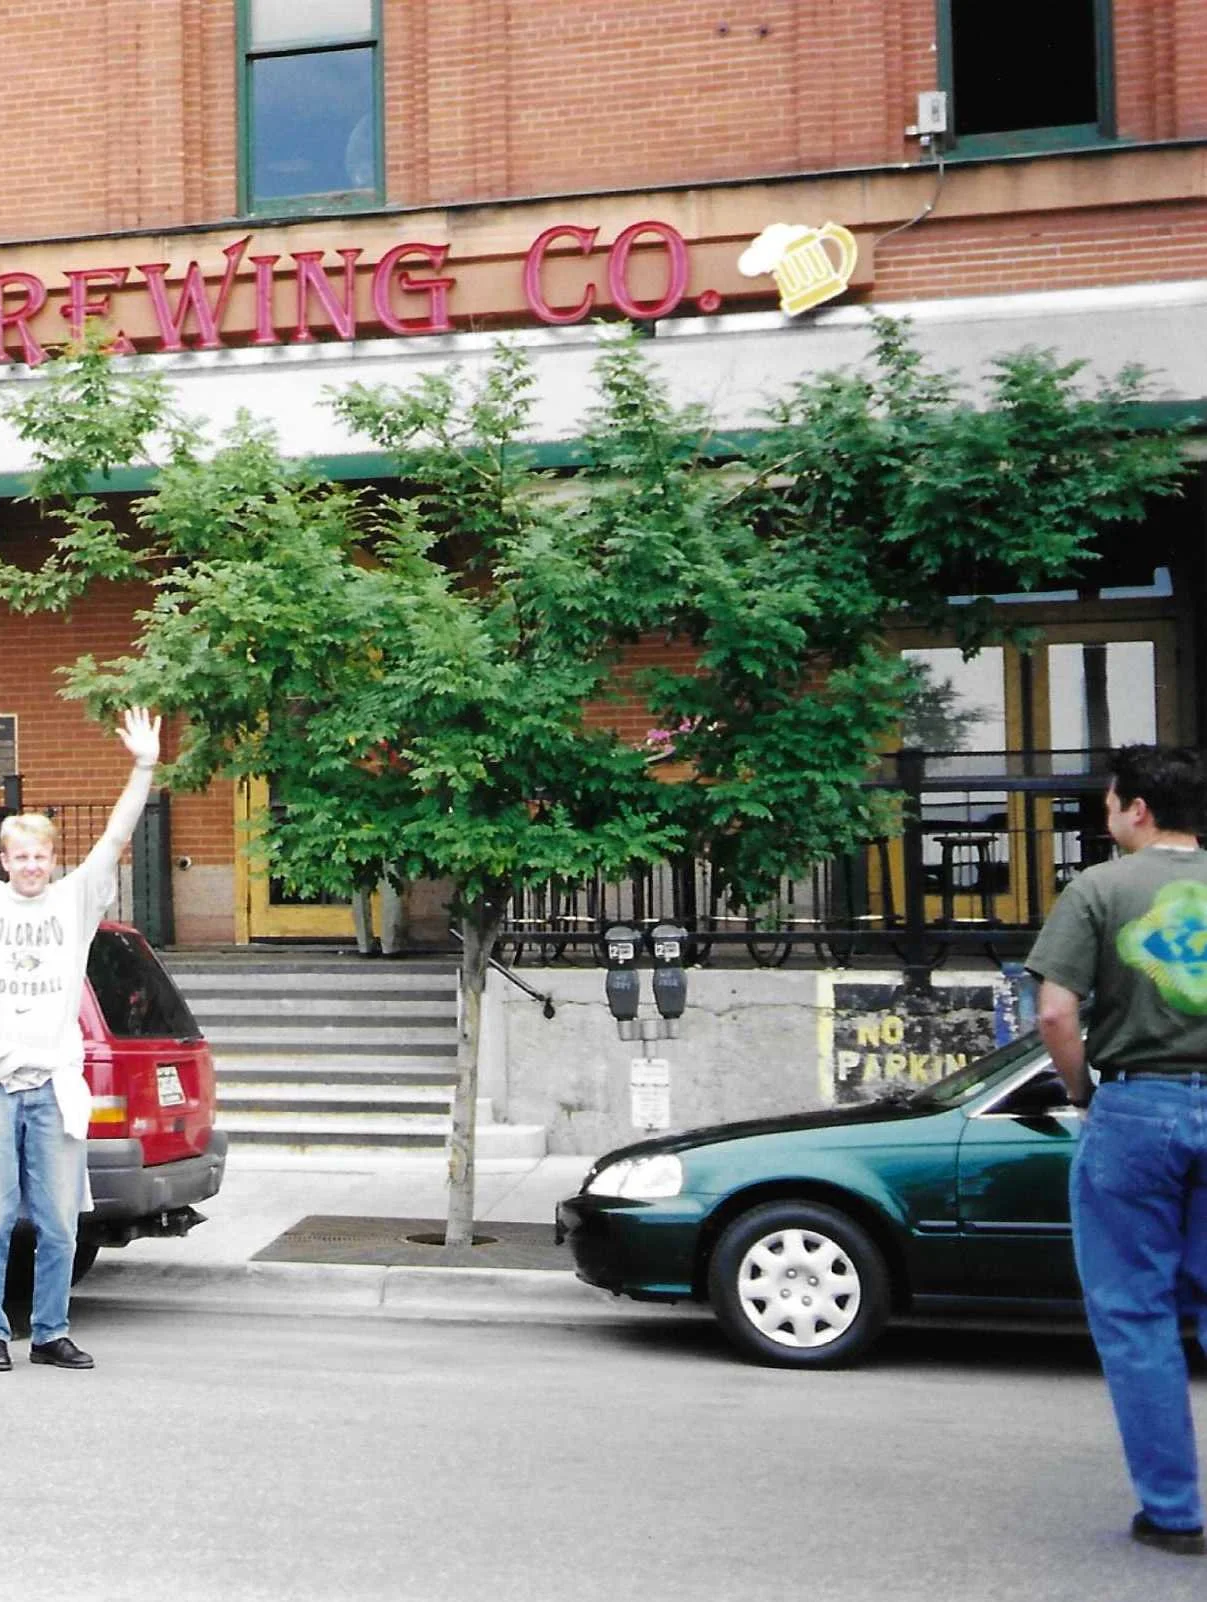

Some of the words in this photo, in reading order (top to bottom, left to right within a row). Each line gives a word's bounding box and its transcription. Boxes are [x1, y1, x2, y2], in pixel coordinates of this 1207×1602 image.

[524, 219, 721, 325] CO.
[857, 1015, 905, 1048] NO
[837, 1049, 982, 1083] PARKIN
